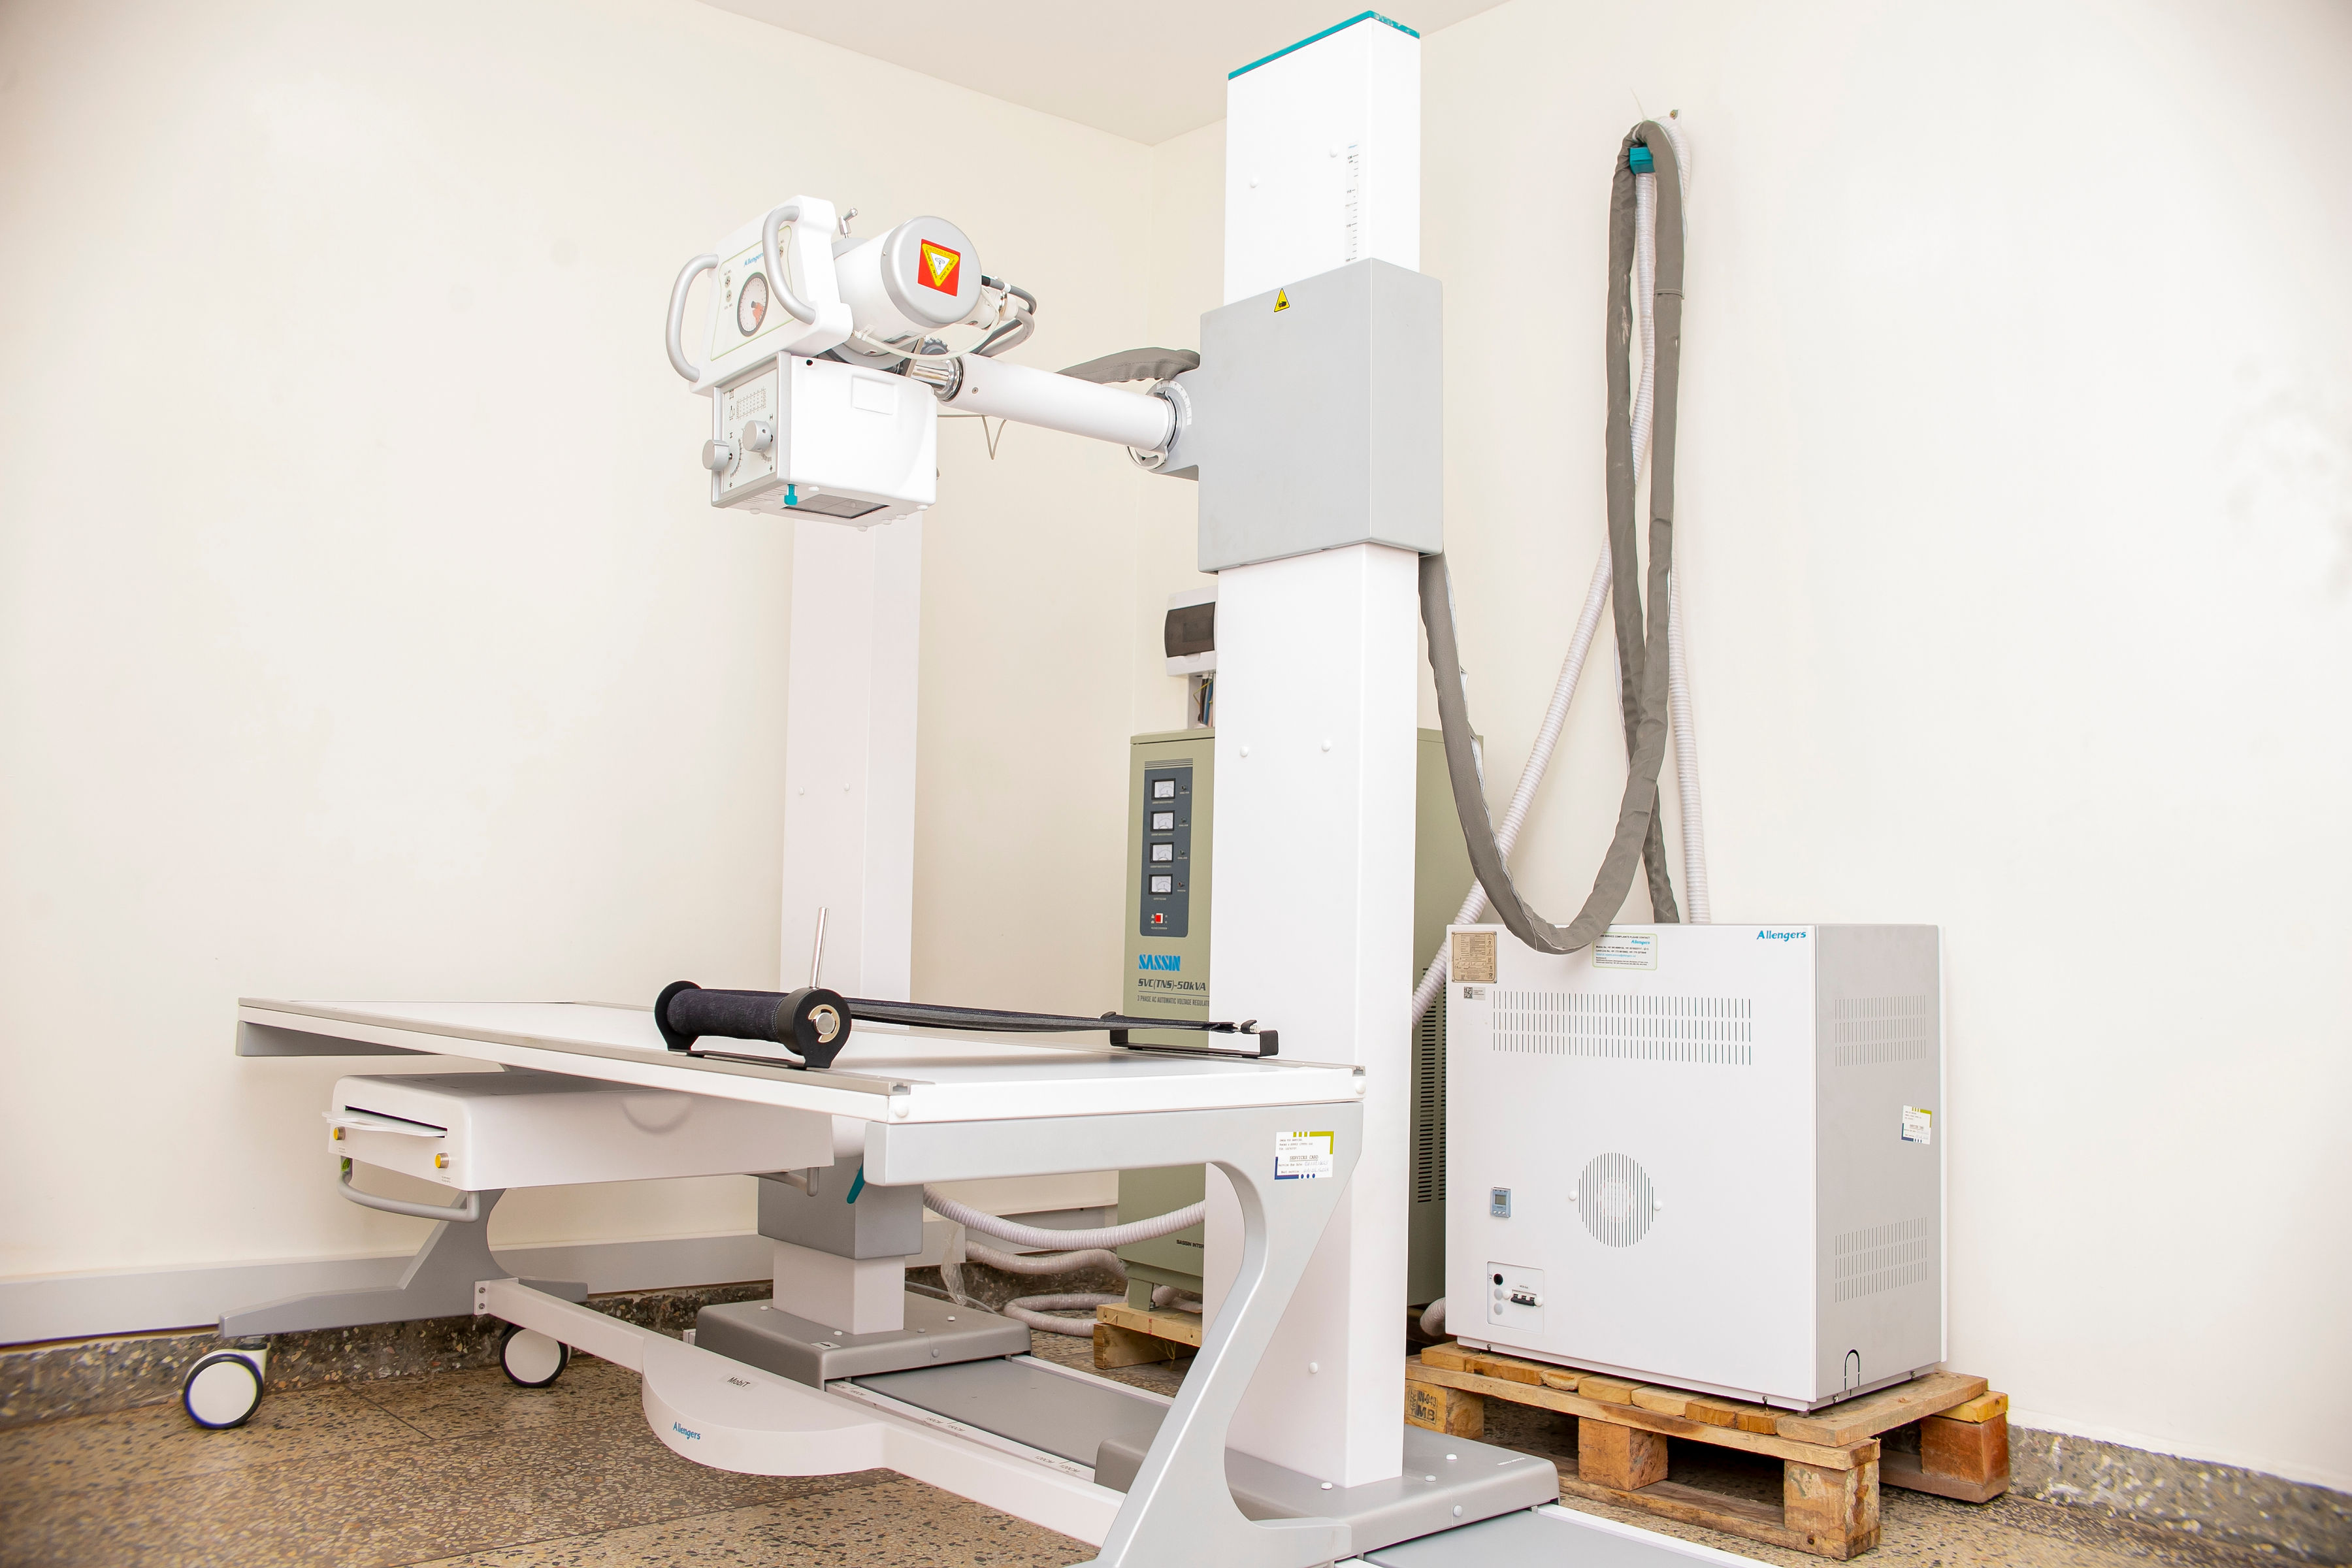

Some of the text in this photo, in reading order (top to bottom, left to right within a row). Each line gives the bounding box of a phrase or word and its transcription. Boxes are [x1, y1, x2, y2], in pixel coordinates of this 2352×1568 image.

[926, 245, 943, 254] CAUTION
[1756, 930, 1806, 942] Allengers
[1139, 954, 1181, 972] SASSIN
[1137, 978, 1206, 991] SVC(TNS)-50kVA
[727, 1376, 751, 1388] MobiT
[1416, 1405, 1435, 1421] MB
[673, 1421, 701, 1441] Allengers
